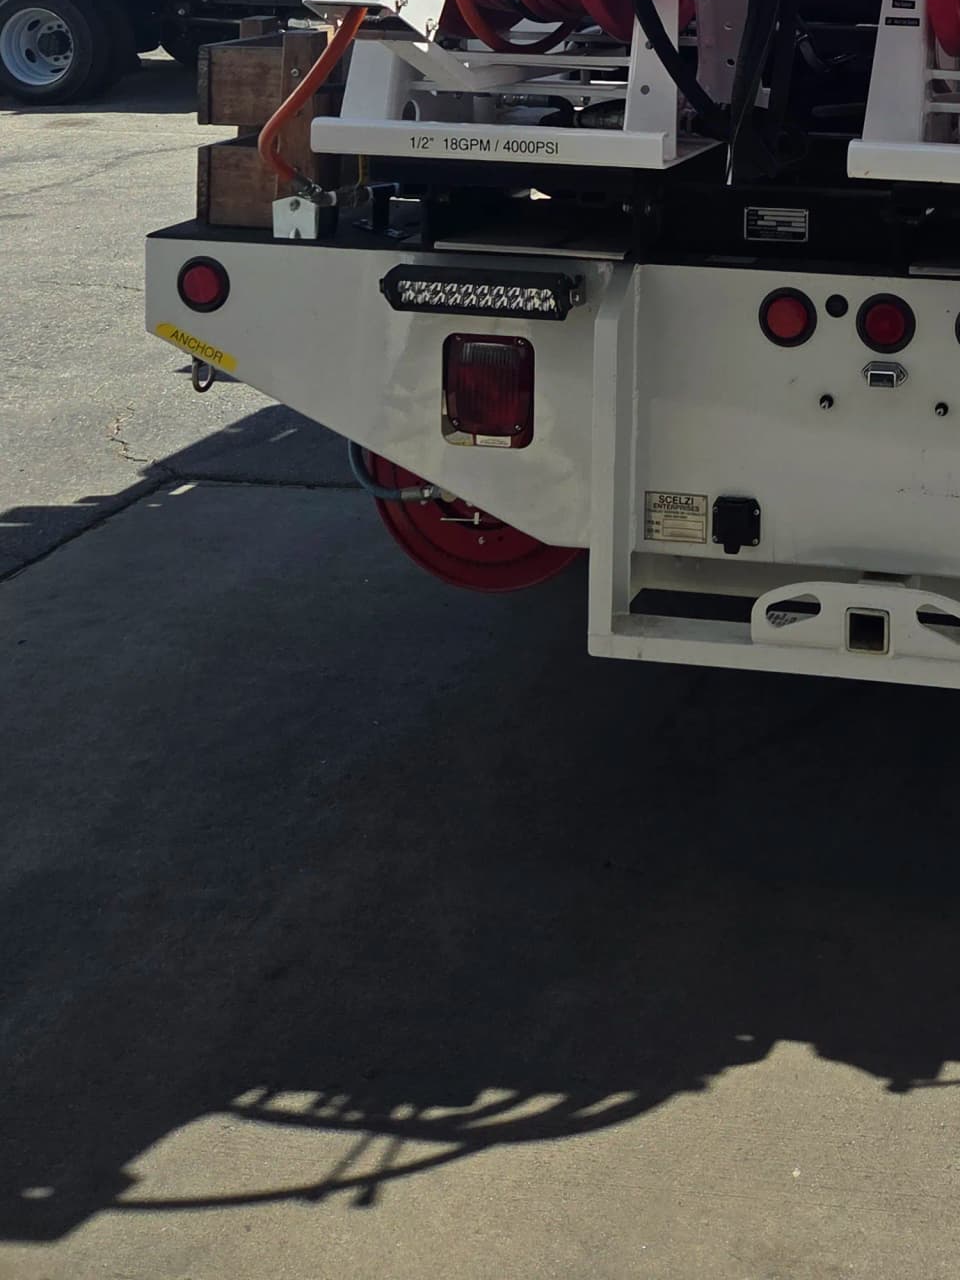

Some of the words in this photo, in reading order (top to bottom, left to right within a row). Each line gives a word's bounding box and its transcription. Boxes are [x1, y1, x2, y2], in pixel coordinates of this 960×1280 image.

[410, 136, 434, 149] 1/2"
[443, 137, 491, 152] 18GPM
[494, 139, 500, 152] /
[503, 140, 559, 154] 4000PSI
[170, 329, 224, 363] ANCHOR
[658, 494, 694, 505] SCELZI
